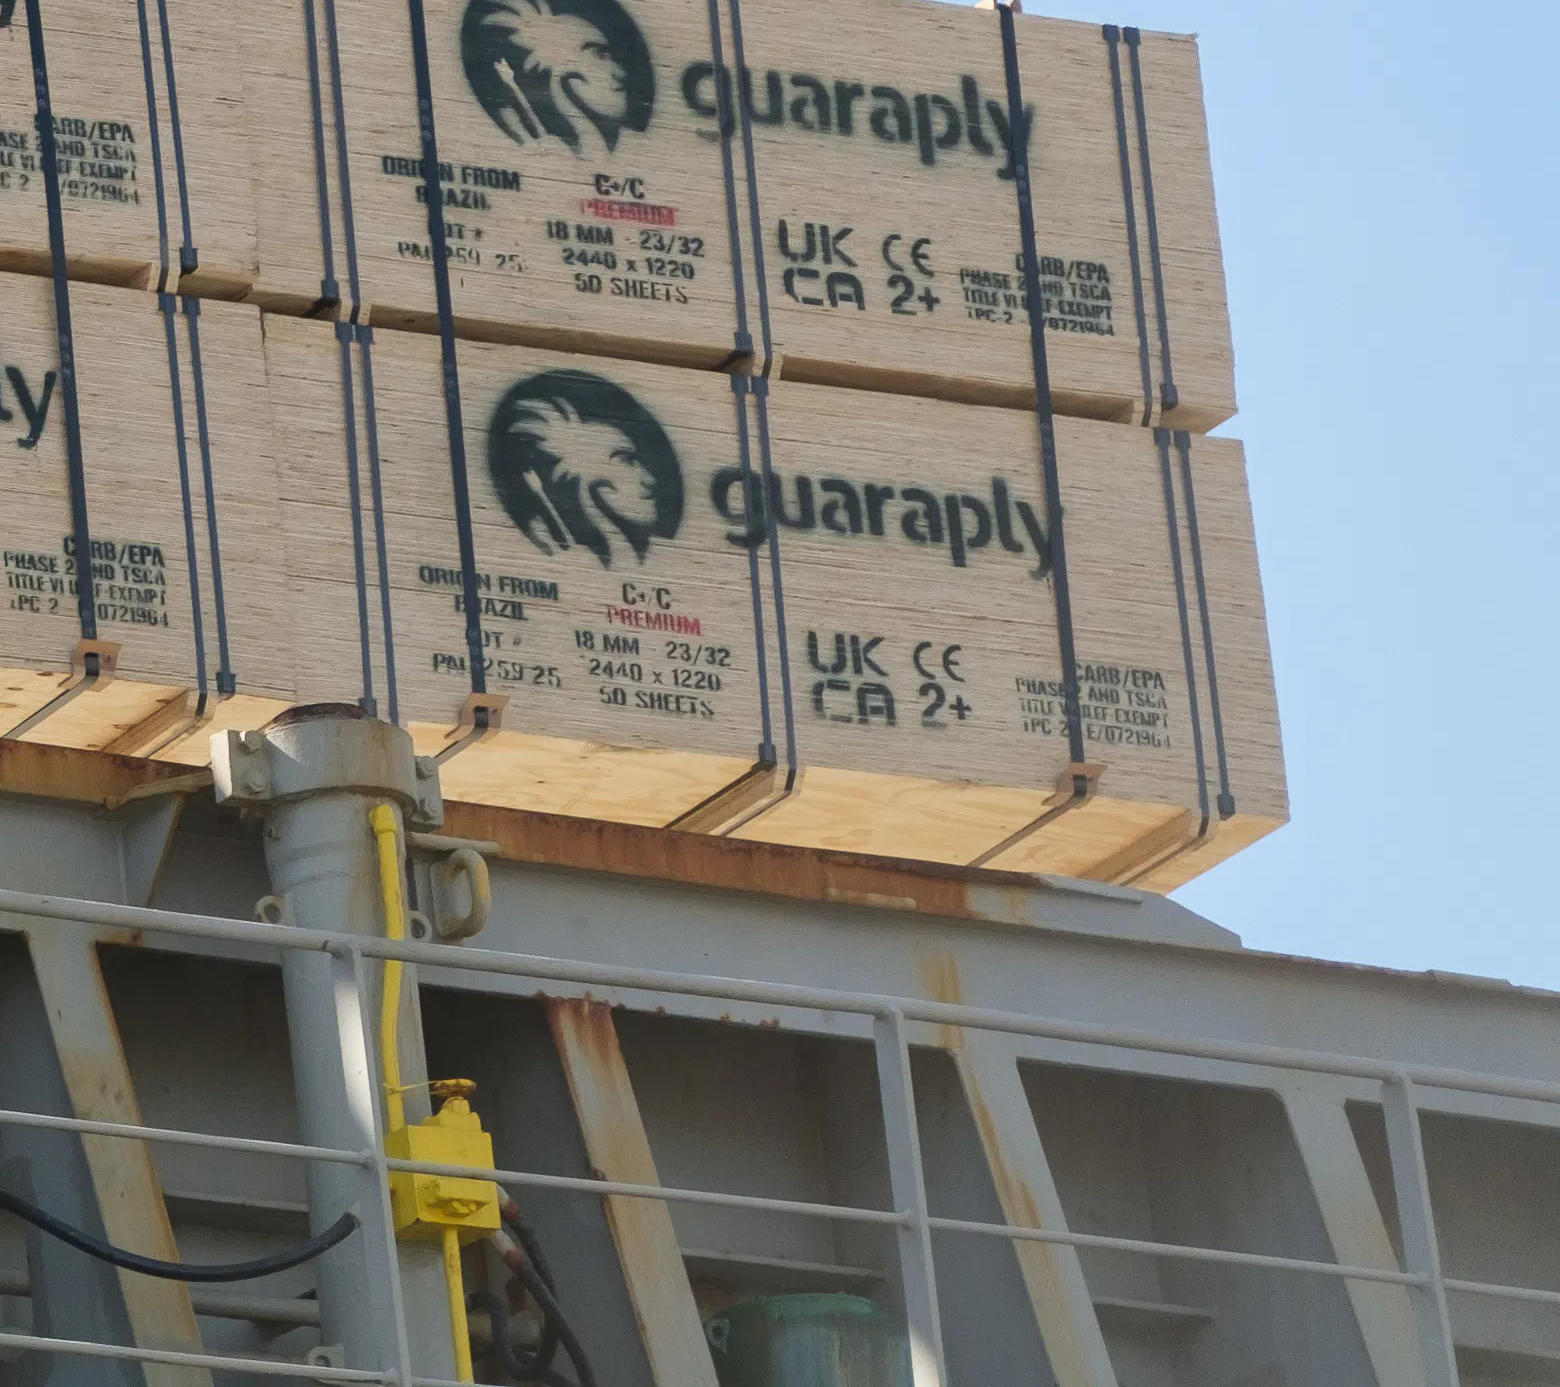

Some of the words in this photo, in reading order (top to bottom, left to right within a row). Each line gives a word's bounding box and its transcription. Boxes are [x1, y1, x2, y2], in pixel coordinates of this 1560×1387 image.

[681, 61, 1035, 180] guaraply
[546, 220, 568, 240] 18
[577, 225, 614, 246] MM
[639, 229, 705, 258] 23/32
[777, 219, 858, 267] UK
[561, 247, 617, 270] 2440
[645, 258, 695, 280] 1220
[574, 273, 602, 294] 50
[610, 278, 689, 304] SHEETS
[783, 268, 865, 311] CA
[887, 273, 941, 316] 2+
[710, 466, 1063, 580] guaraply
[499, 576, 559, 600] FROM
[606, 605, 702, 636] PREMIUM
[574, 630, 595, 650] 18
[603, 634, 640, 655] MM
[665, 640, 731, 667] 23/32
[807, 630, 888, 677] UK
[588, 658, 643, 682] 2440
[672, 669, 720, 691] 1220
[599, 686, 627, 706] 50
[635, 691, 715, 717] SHEETS
[811, 678, 896, 726] CA
[917, 682, 973, 728] 2+
